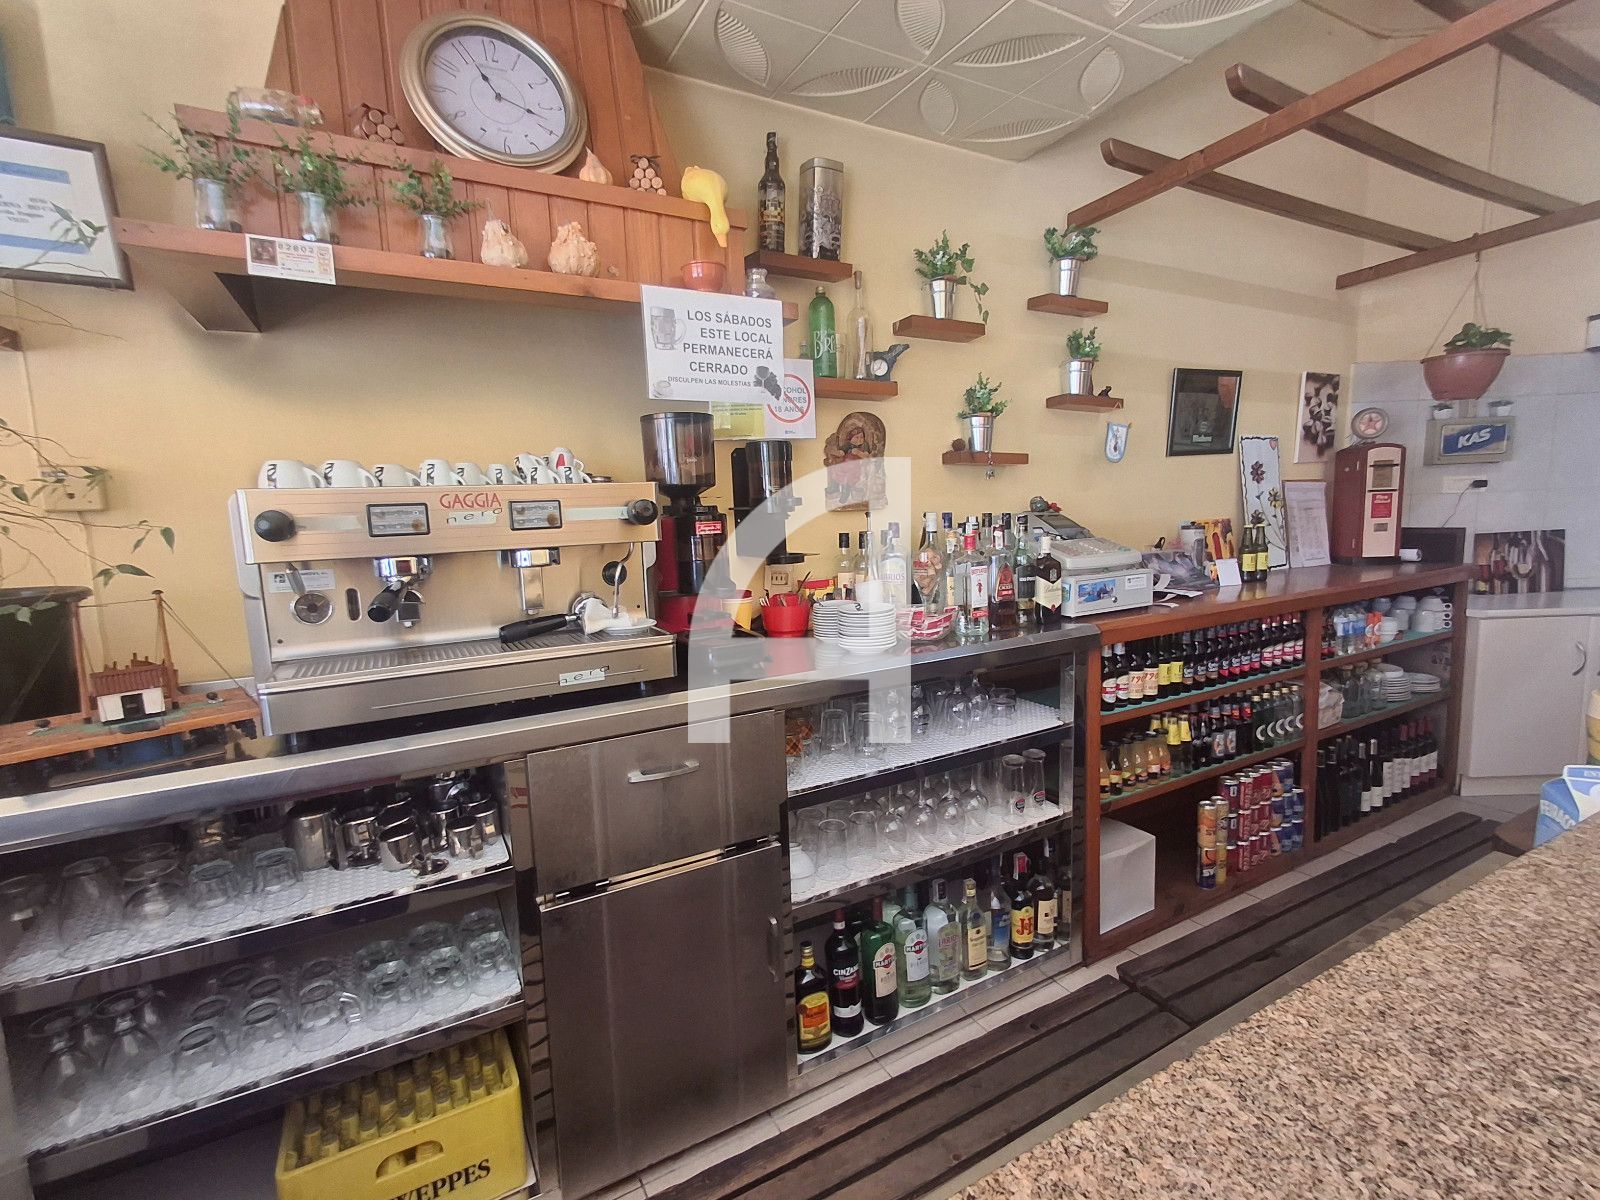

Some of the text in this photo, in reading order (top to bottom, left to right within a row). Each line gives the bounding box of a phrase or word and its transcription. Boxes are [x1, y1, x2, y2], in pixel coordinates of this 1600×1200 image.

[481, 38, 499, 63] 12
[687, 310, 772, 328] LOS SÁBADOS
[700, 327, 773, 344] ESTE LOCAL
[683, 342, 773, 360] PERMANECERÁ
[689, 361, 748, 375] CERRADO
[667, 376, 704, 384] DISCULPEN
[717, 379, 751, 387] MOLESTIAS
[1458, 427, 1492, 449] KAS
[440, 493, 502, 509] GAGGIA
[446, 507, 503, 524] nero
